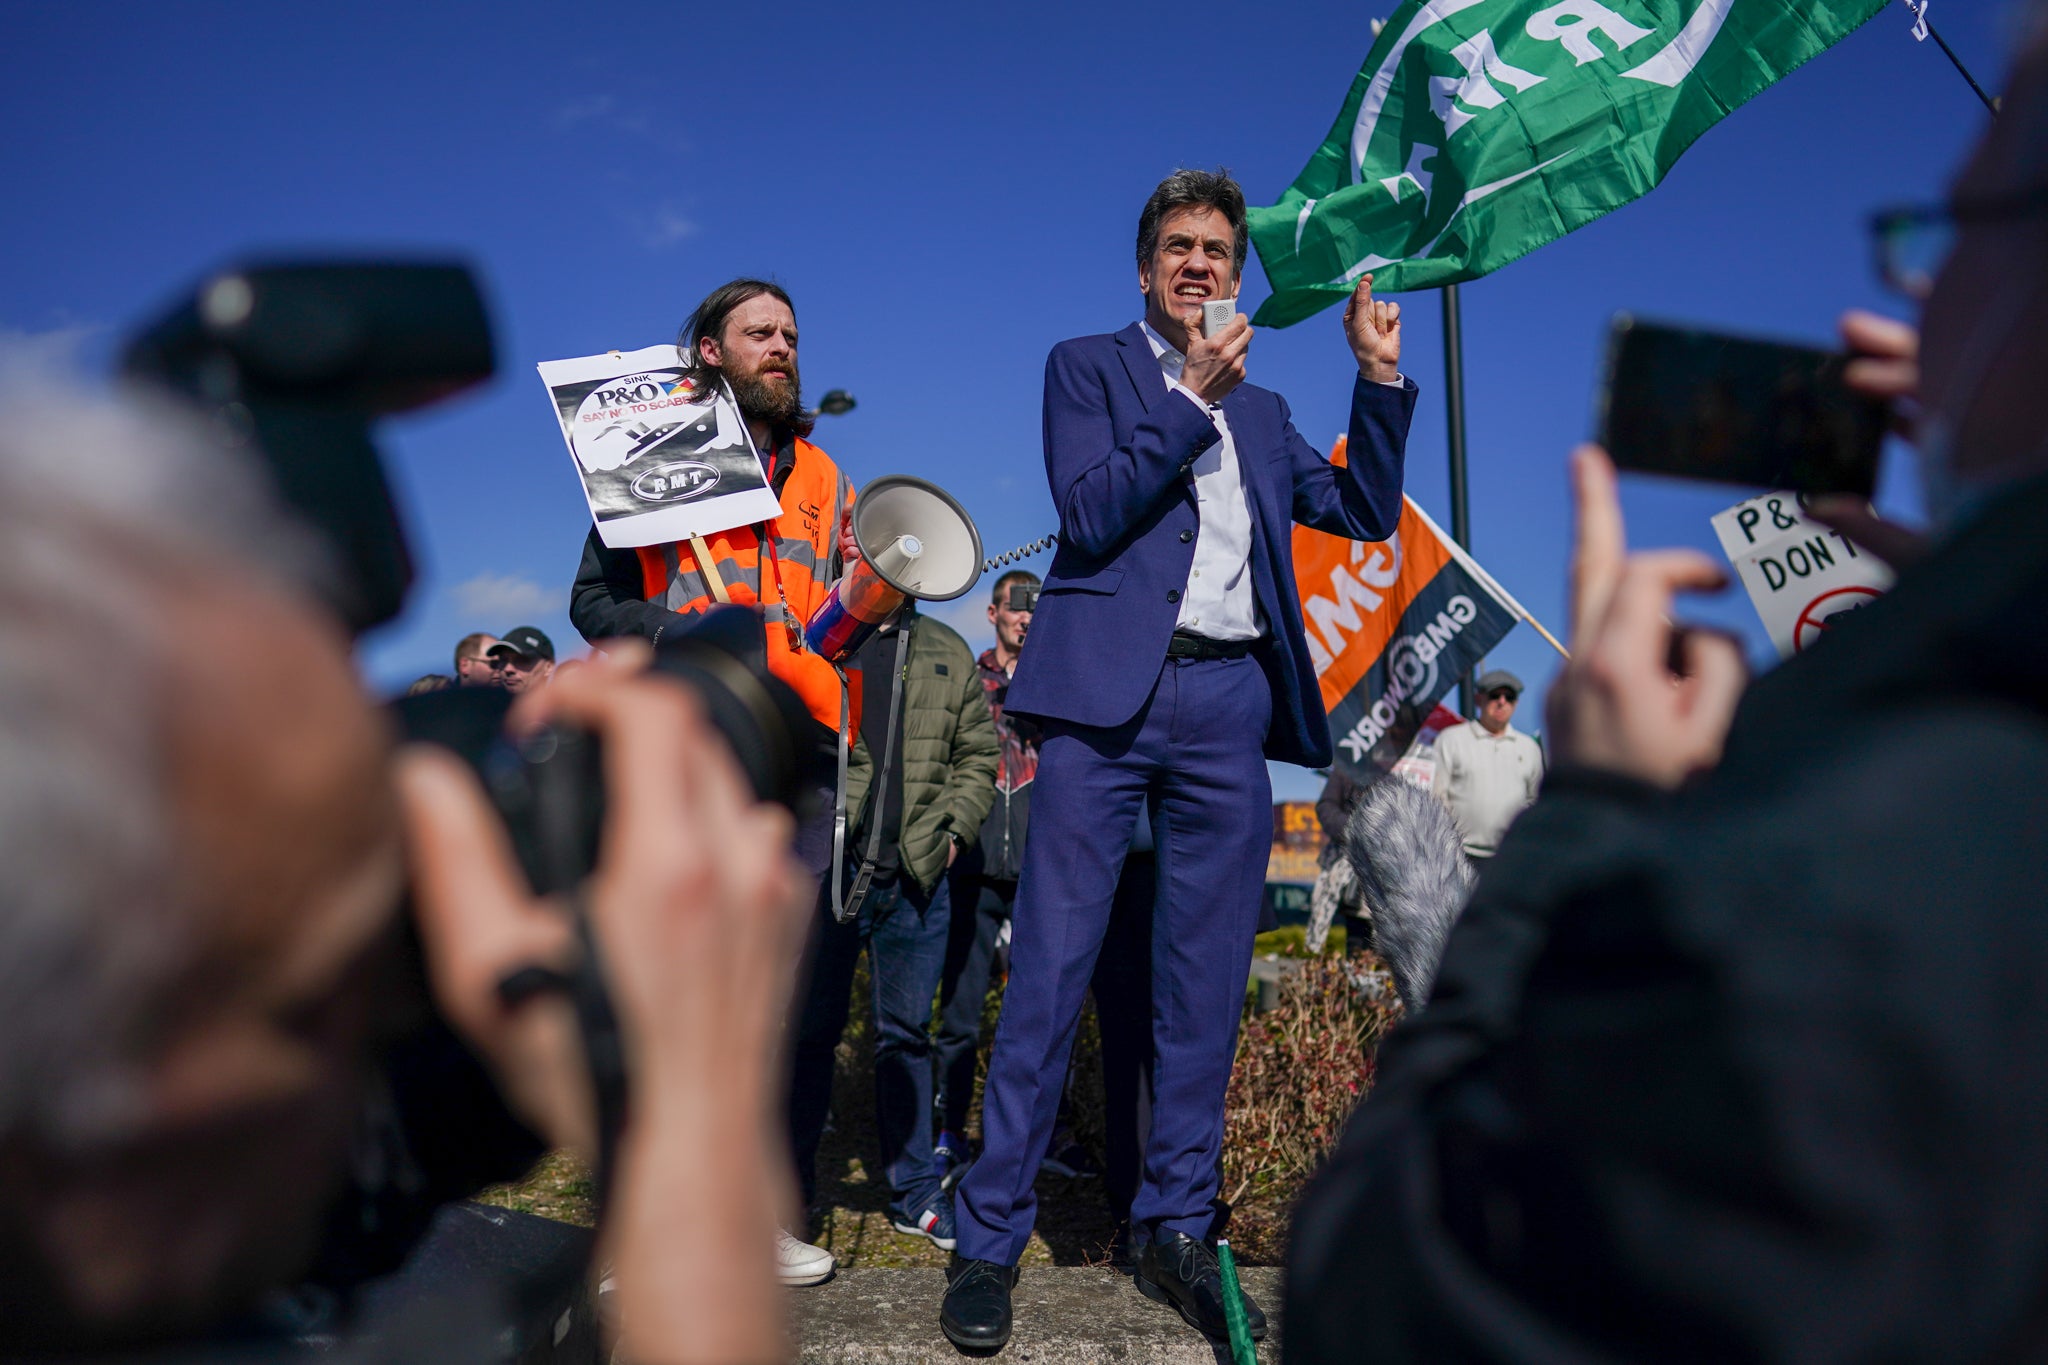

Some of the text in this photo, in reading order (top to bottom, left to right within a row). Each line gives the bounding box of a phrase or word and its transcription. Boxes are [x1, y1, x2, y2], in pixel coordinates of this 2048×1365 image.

[624, 374, 651, 385] SINK
[594, 383, 659, 409] P&O
[582, 411, 607, 423] SAY
[629, 404, 648, 415] TO
[653, 470, 701, 493] RMT
